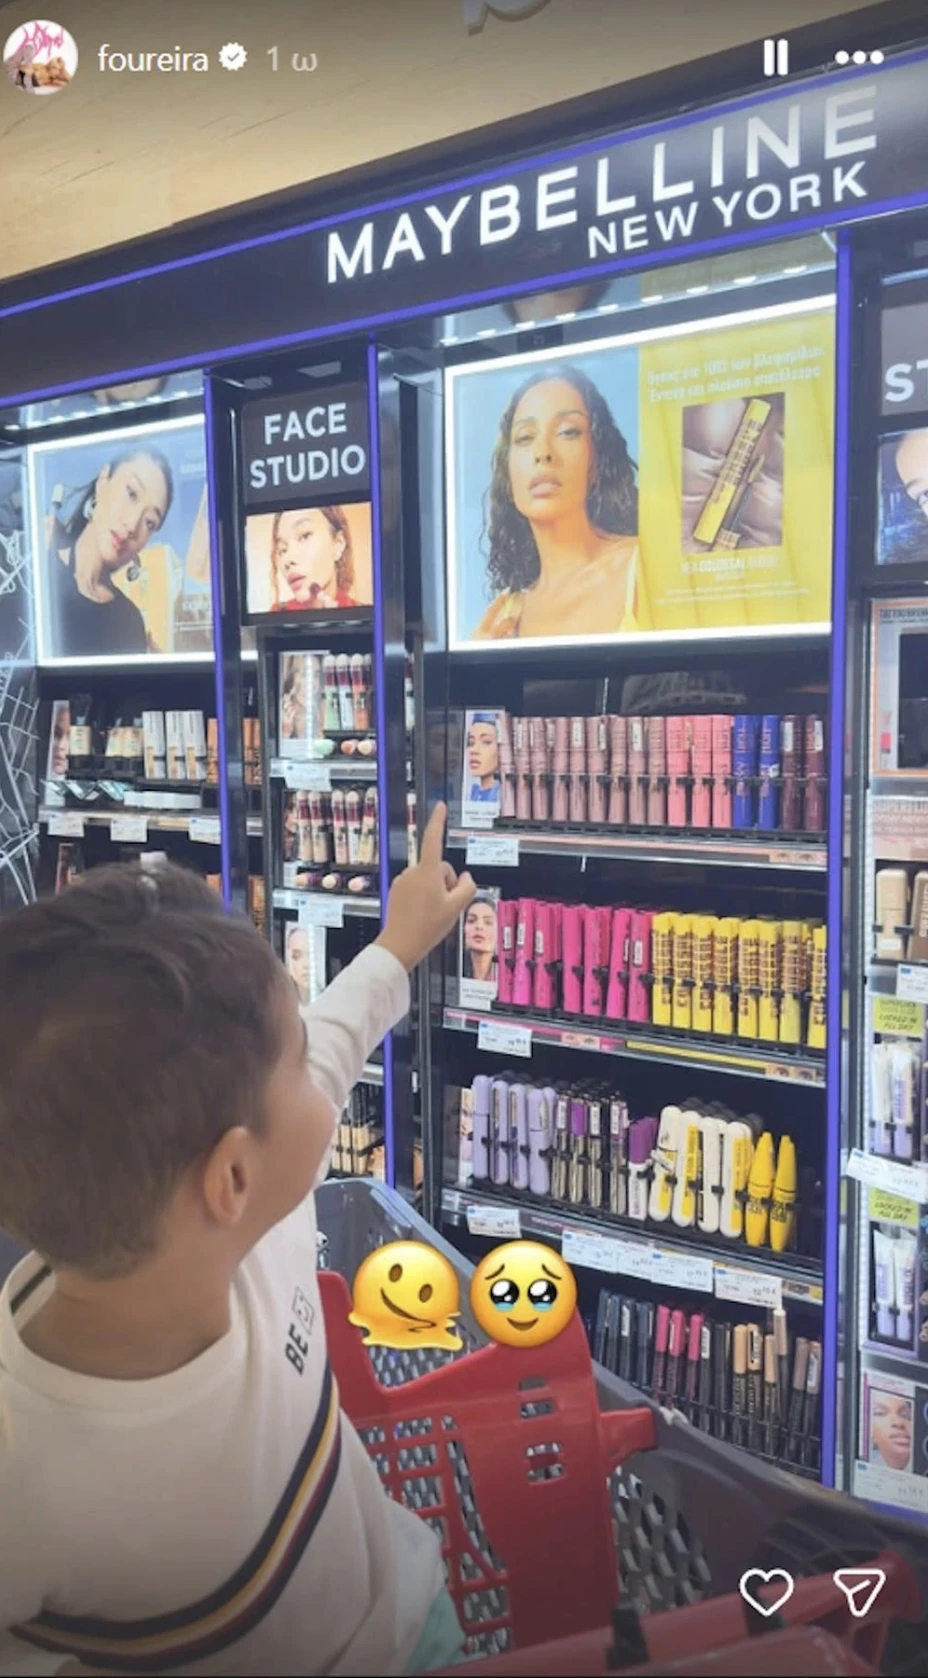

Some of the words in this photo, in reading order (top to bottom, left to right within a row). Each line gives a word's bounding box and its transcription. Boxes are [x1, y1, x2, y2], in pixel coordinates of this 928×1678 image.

[326, 85, 879, 284] MAYBELLINE
[587, 201, 700, 259] NEW
[714, 160, 869, 228] YORK
[263, 402, 348, 446] FACE
[249, 444, 367, 490] STUDIO
[284, 1324, 309, 1376] BE
